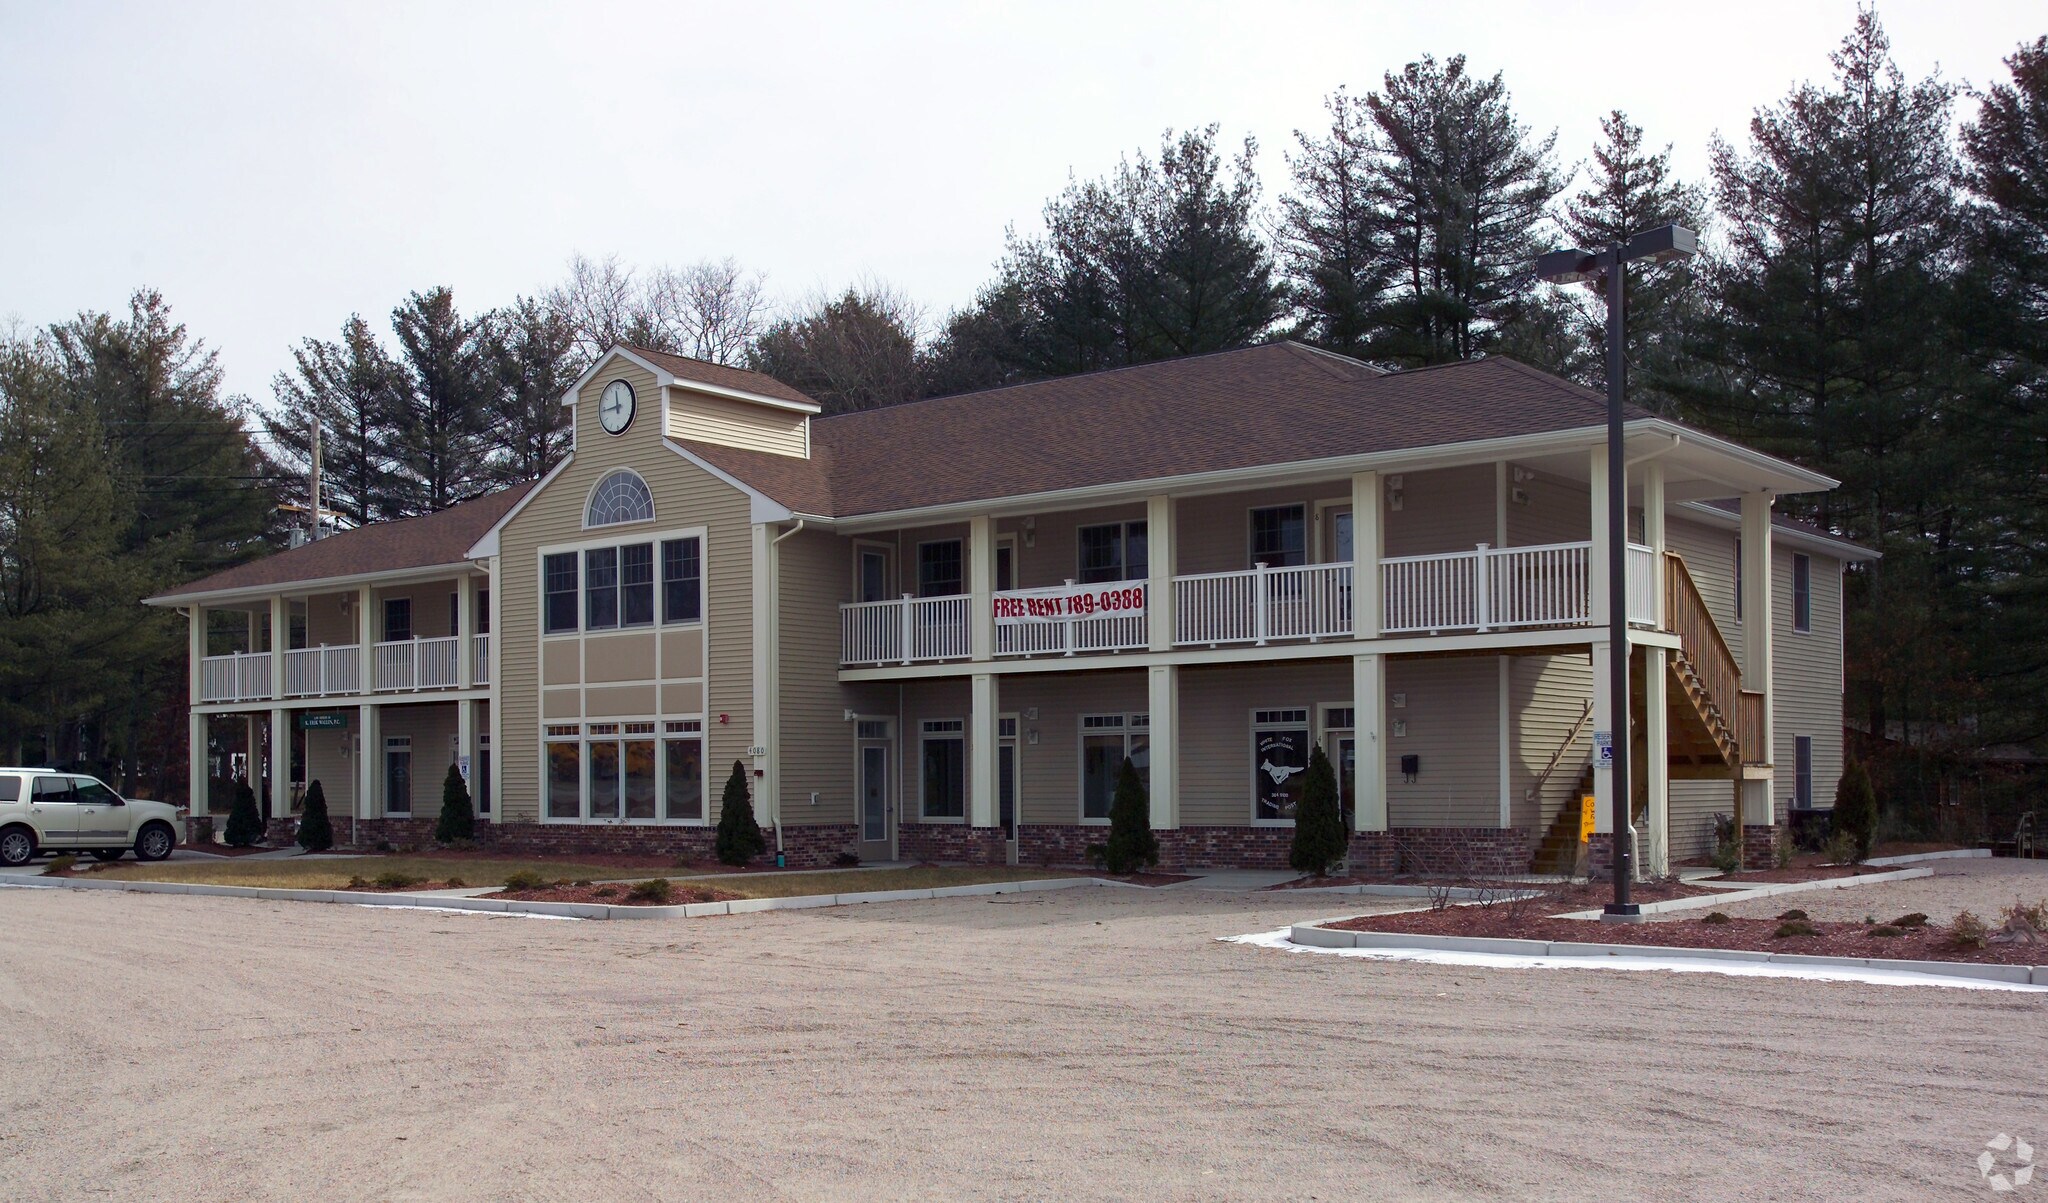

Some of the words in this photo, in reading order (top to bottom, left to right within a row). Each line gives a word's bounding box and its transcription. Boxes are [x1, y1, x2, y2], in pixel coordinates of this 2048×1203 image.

[993, 597, 1026, 618] FREE
[1026, 597, 1063, 617] RENT
[1065, 587, 1143, 615] 789-0388
[1260, 737, 1273, 746] WHITE
[1261, 742, 1294, 752] INTERNATIONAL
[1261, 797, 1280, 810] TRADING
[1285, 801, 1297, 810] POST
